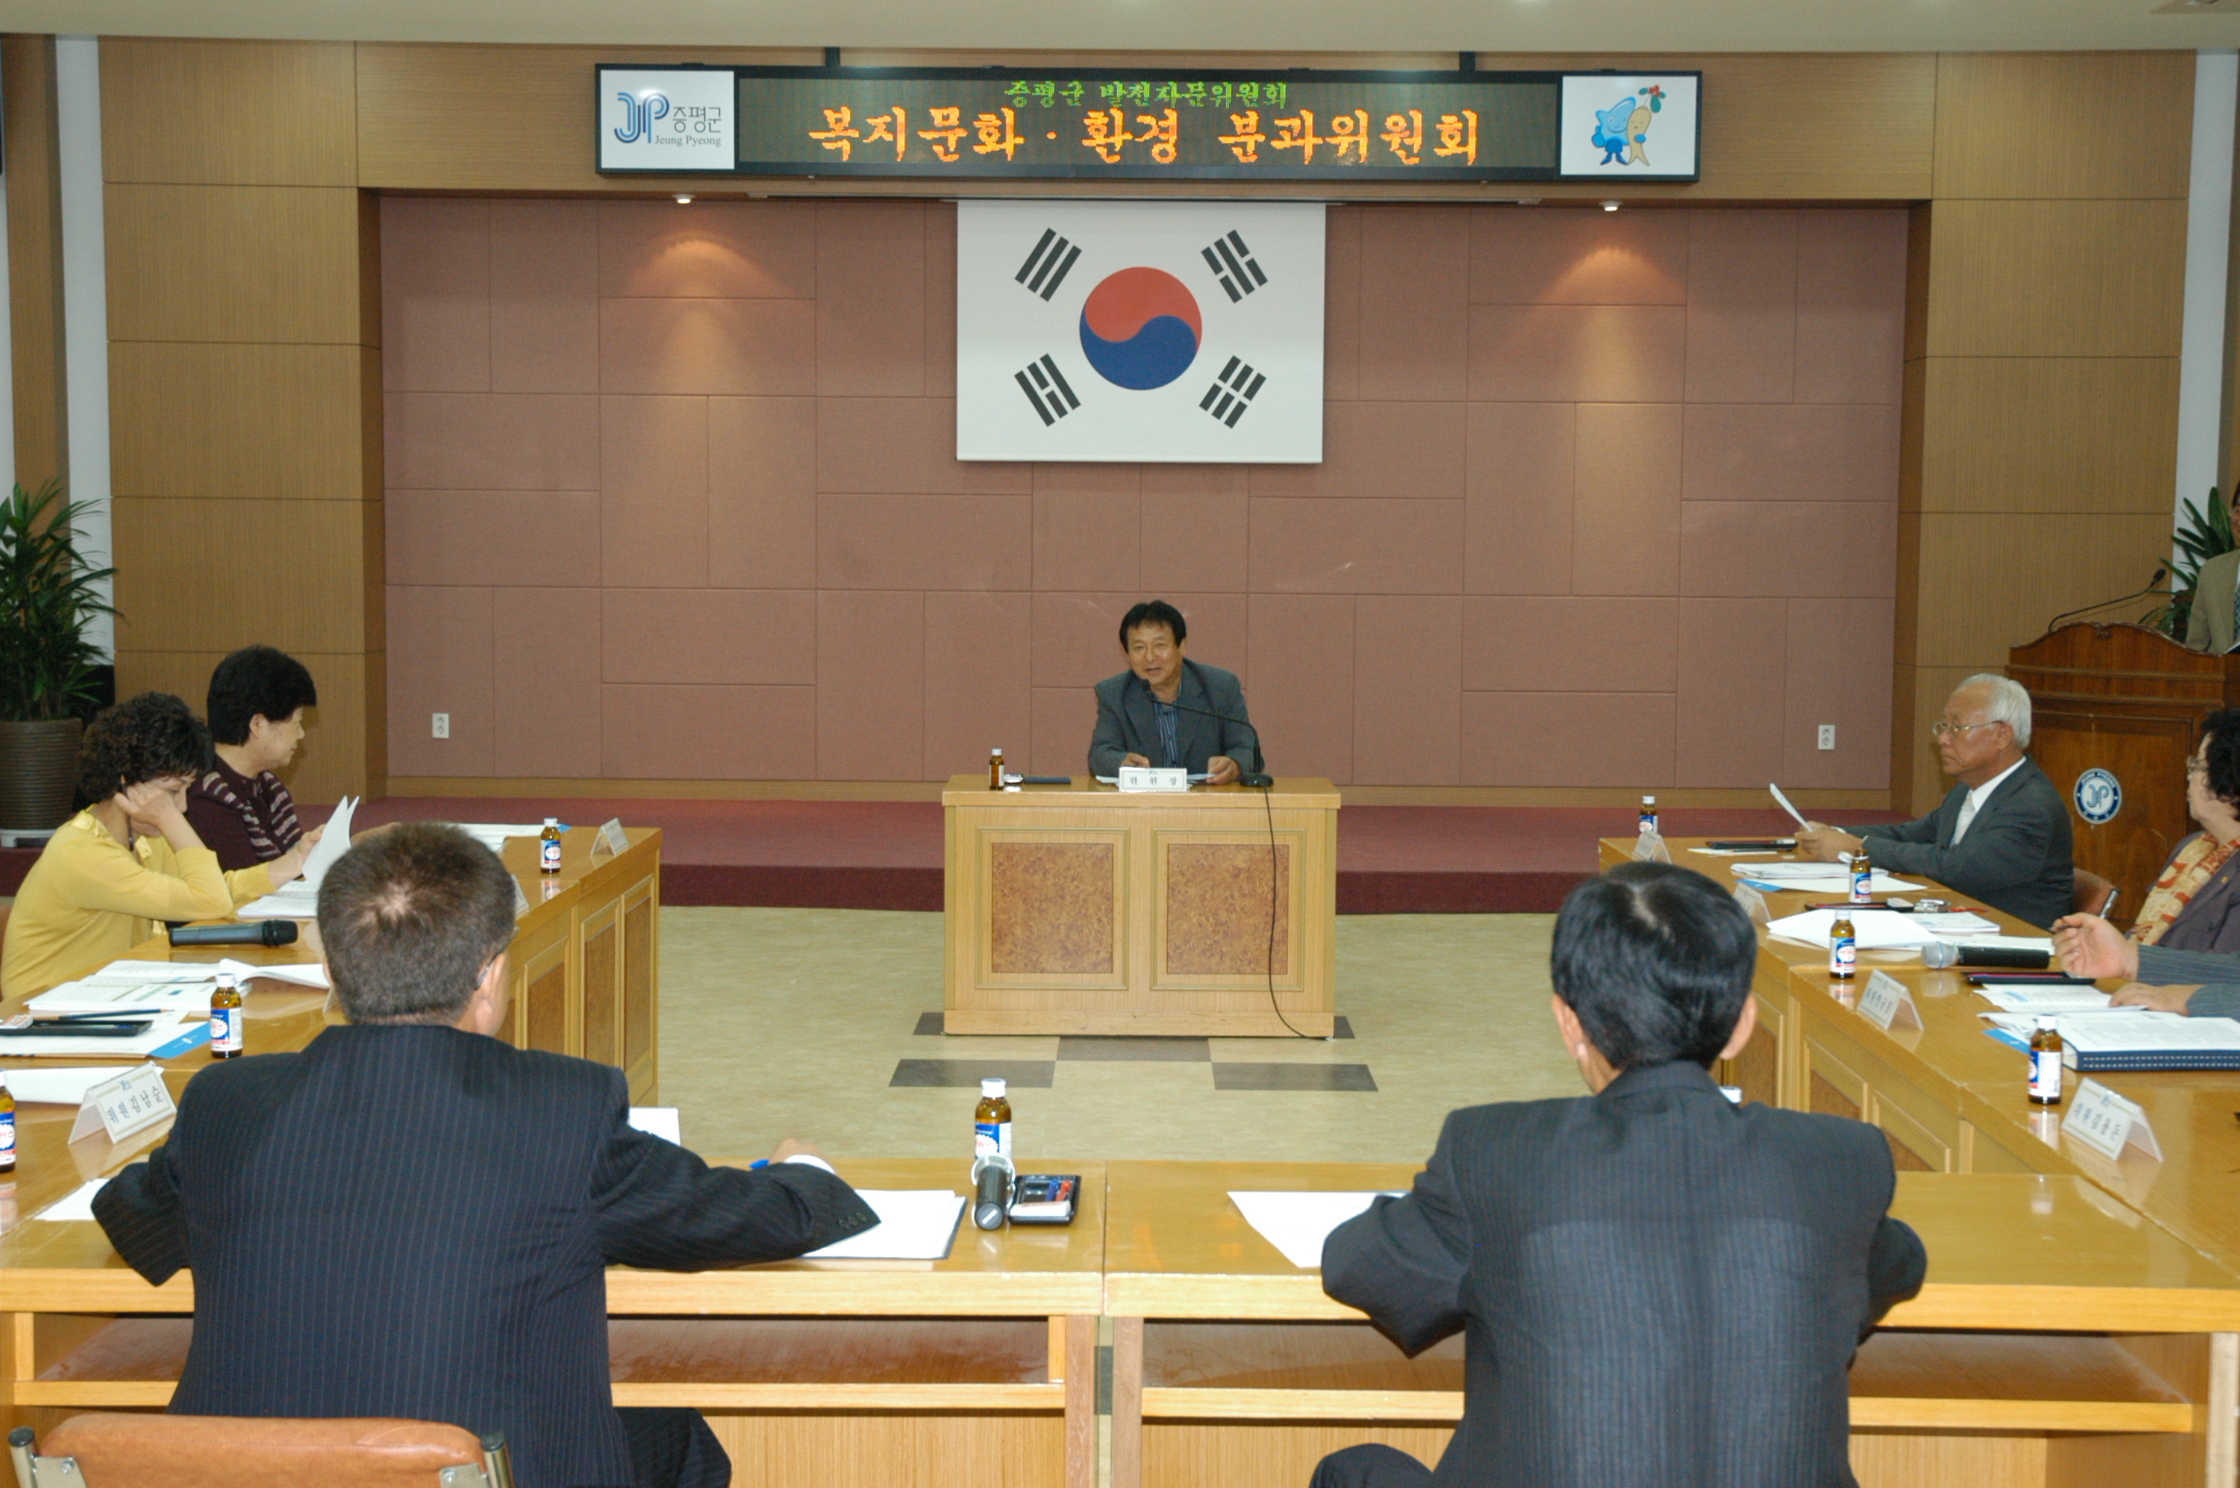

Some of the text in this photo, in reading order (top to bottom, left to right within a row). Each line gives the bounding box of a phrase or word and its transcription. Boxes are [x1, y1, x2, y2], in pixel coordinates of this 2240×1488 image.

[1004, 80, 1084, 108] 증평군
[672, 105, 722, 133] 증평군
[654, 134, 722, 148] Jeung Pyeong
[808, 105, 1025, 162] 복지문화
[1082, 106, 1178, 164] 환경
[1218, 108, 1479, 165] 분과위원회
[107, 1100, 131, 1124] 위원
